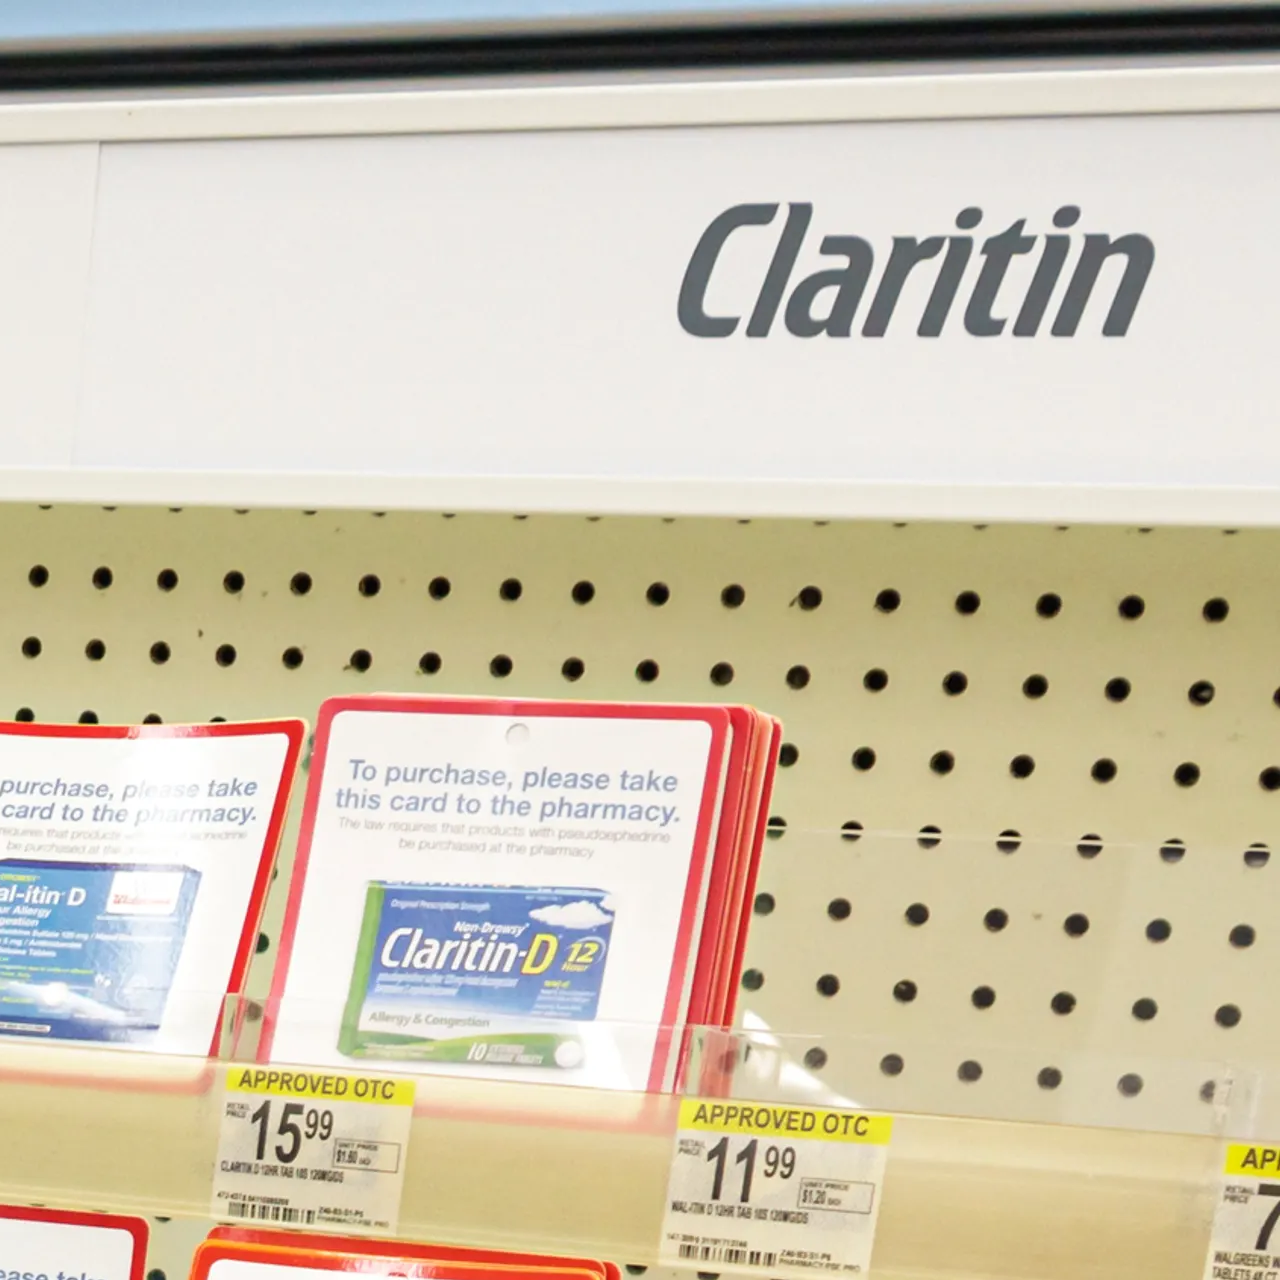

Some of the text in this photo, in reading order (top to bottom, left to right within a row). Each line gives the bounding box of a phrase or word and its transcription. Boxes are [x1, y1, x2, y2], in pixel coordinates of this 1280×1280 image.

[677, 202, 1155, 339] Claritin
[381, 928, 558, 974] Claritin-D
[239, 1070, 395, 1099] APPROVED OTC
[693, 1104, 869, 1137] APPROVED OTC
